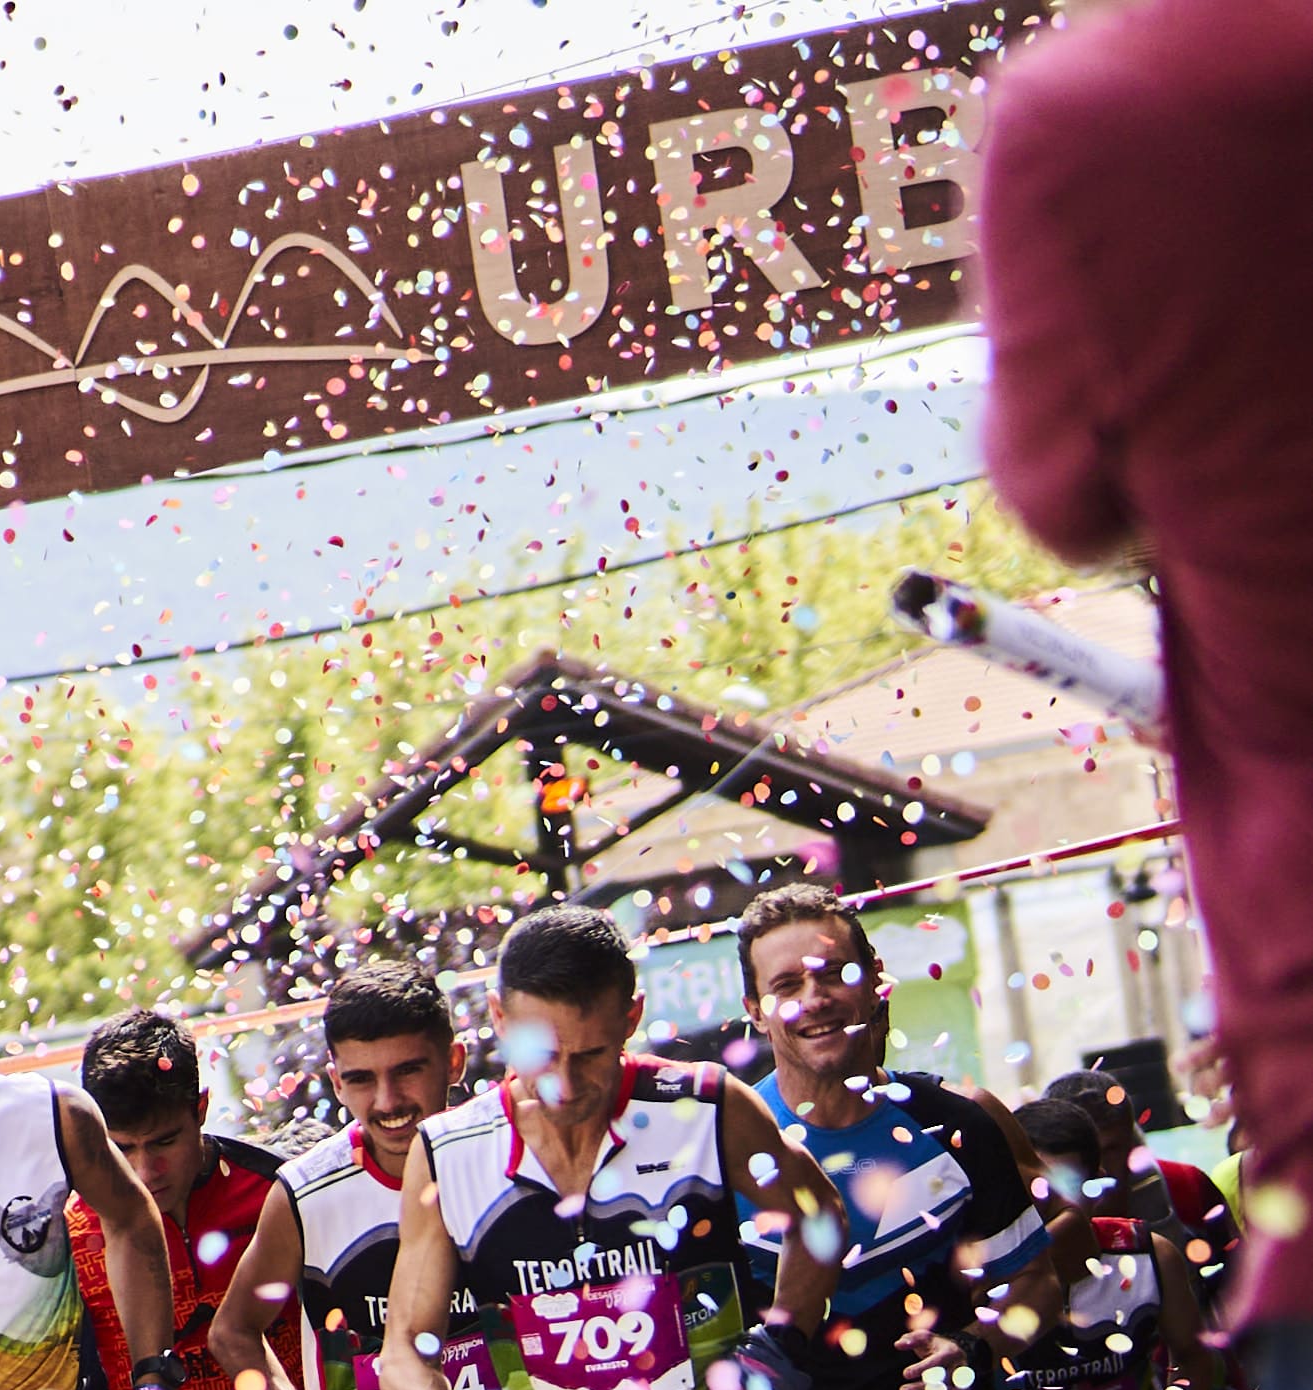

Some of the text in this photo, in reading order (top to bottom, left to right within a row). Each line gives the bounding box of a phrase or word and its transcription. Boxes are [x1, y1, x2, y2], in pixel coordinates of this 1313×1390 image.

[637, 957, 735, 1013] RBI
[589, 1239, 663, 1279] TRAIL
[548, 1311, 655, 1364] 709
[585, 1360, 629, 1373] EVARISTO
